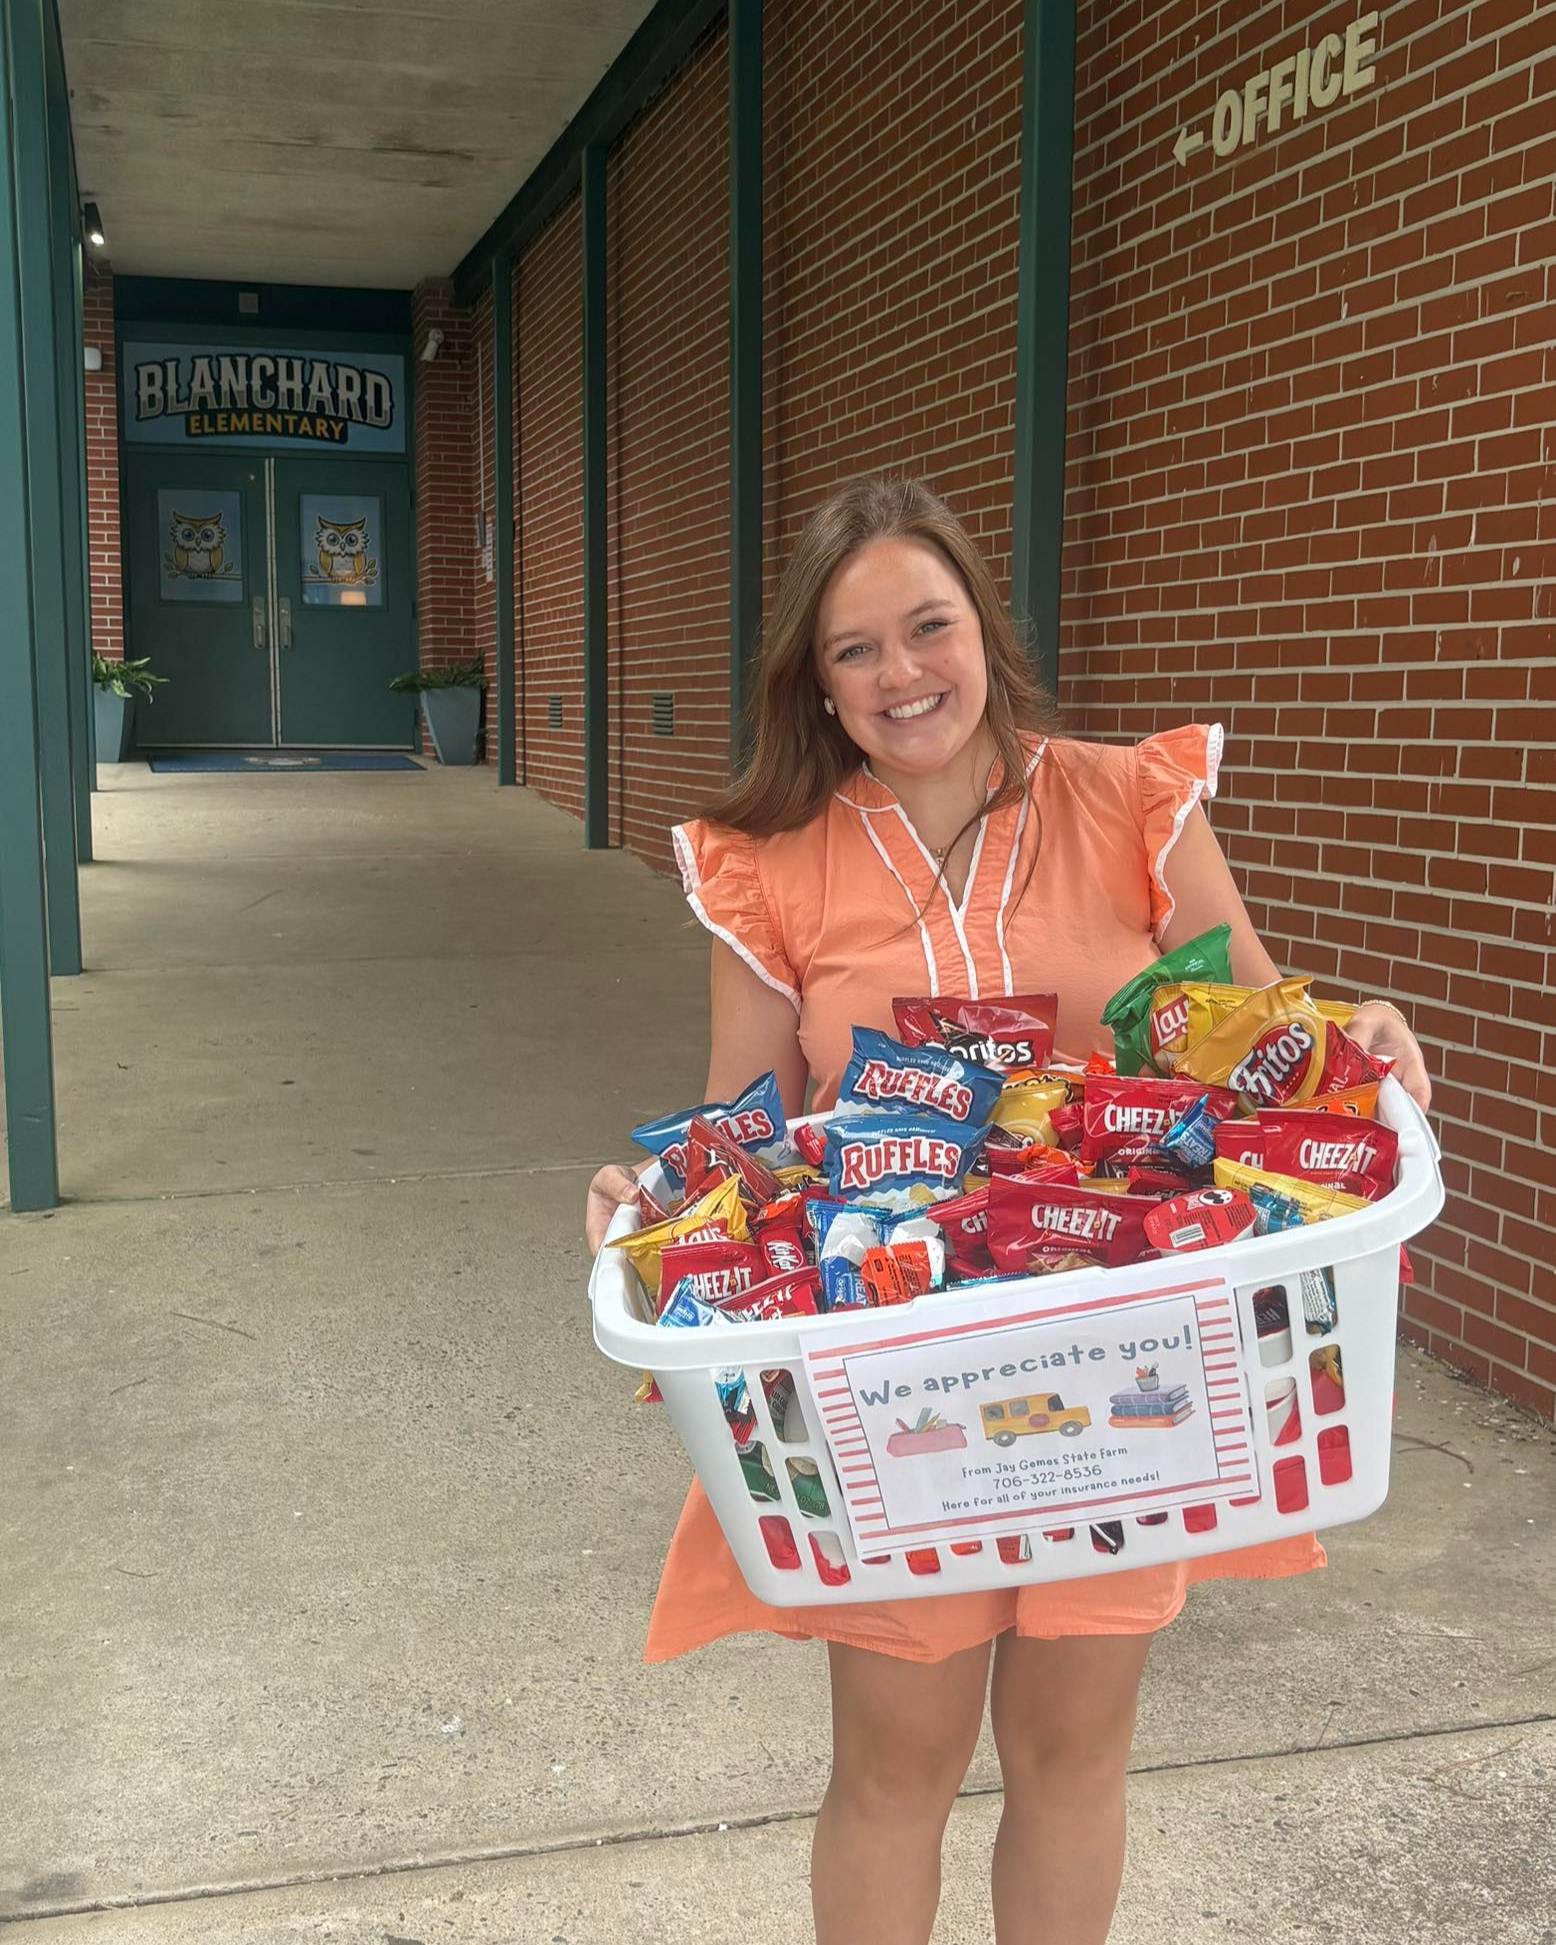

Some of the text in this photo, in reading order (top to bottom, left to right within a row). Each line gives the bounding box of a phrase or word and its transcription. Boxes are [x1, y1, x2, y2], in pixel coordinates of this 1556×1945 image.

[1212, 11, 1379, 156] OFFICE
[136, 355, 394, 428] BLANCHARD
[189, 412, 345, 441] ELEMENTARY
[926, 1035, 1032, 1064] oritos
[1227, 1022, 1314, 1104] Fritos
[853, 1059, 973, 1122] RUFFLES
[660, 1108, 774, 1178] RLES
[841, 1136, 962, 1190] RUFFLES
[859, 1325, 1193, 1406] We appreciate you!
[942, 1470, 1160, 1512] Here for all of your insurance needs!
[961, 1466, 992, 1479] From
[996, 1463, 1016, 1474] Jay
[1062, 1452, 1097, 1465] State
[1099, 1447, 1128, 1460] Farm
[993, 1465, 1103, 1490] 706-322-8536
